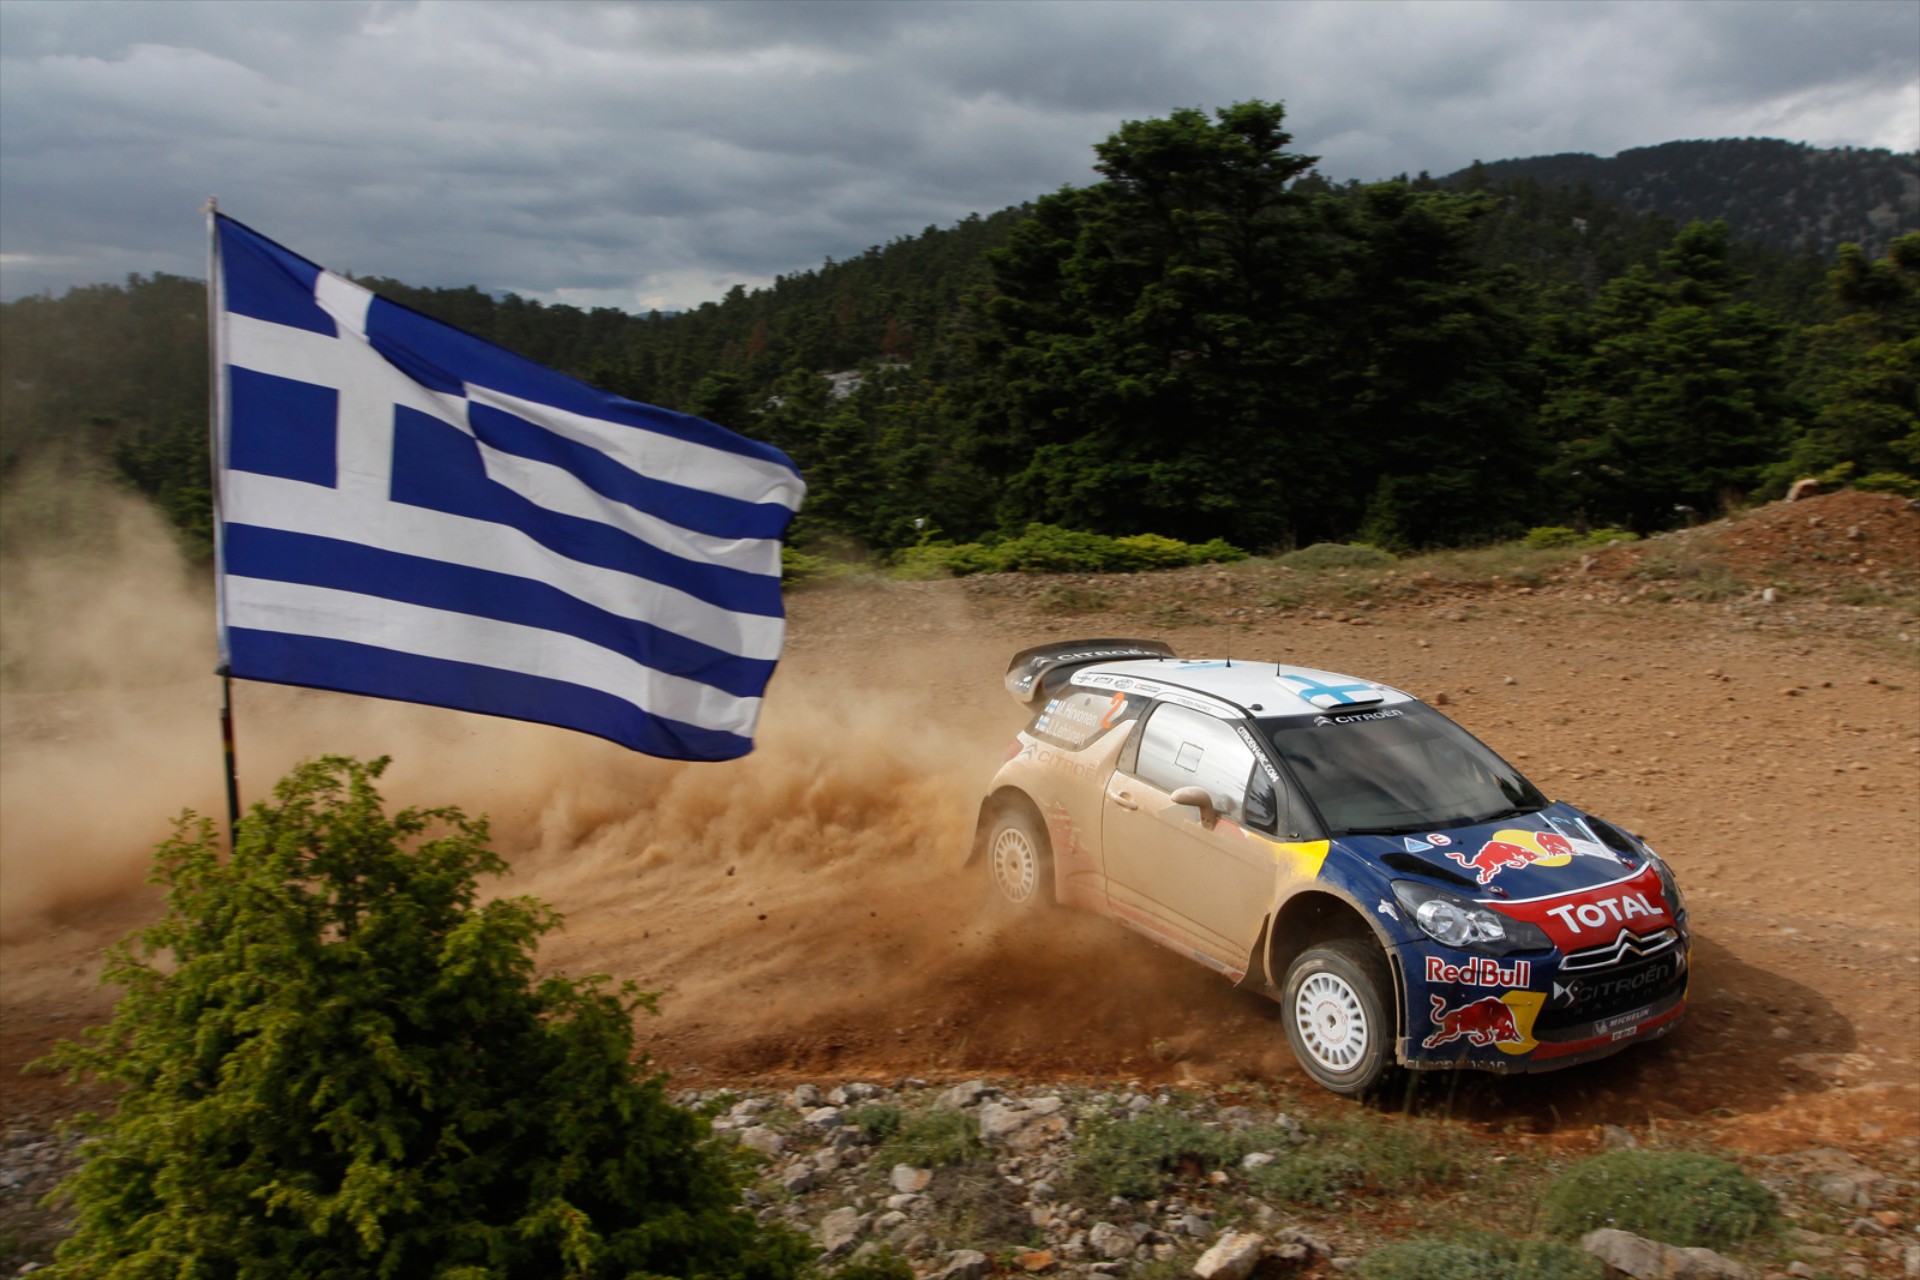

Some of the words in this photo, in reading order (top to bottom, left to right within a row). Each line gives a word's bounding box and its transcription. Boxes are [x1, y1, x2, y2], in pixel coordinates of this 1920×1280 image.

[1063, 702, 1098, 727] Hirvonen
[1101, 691, 1126, 729] 2
[1546, 893, 1664, 933] TOTAL
[1426, 956, 1478, 985] Red
[1479, 958, 1531, 988] Bull
[1609, 1007, 1650, 1028] MICHELIN
